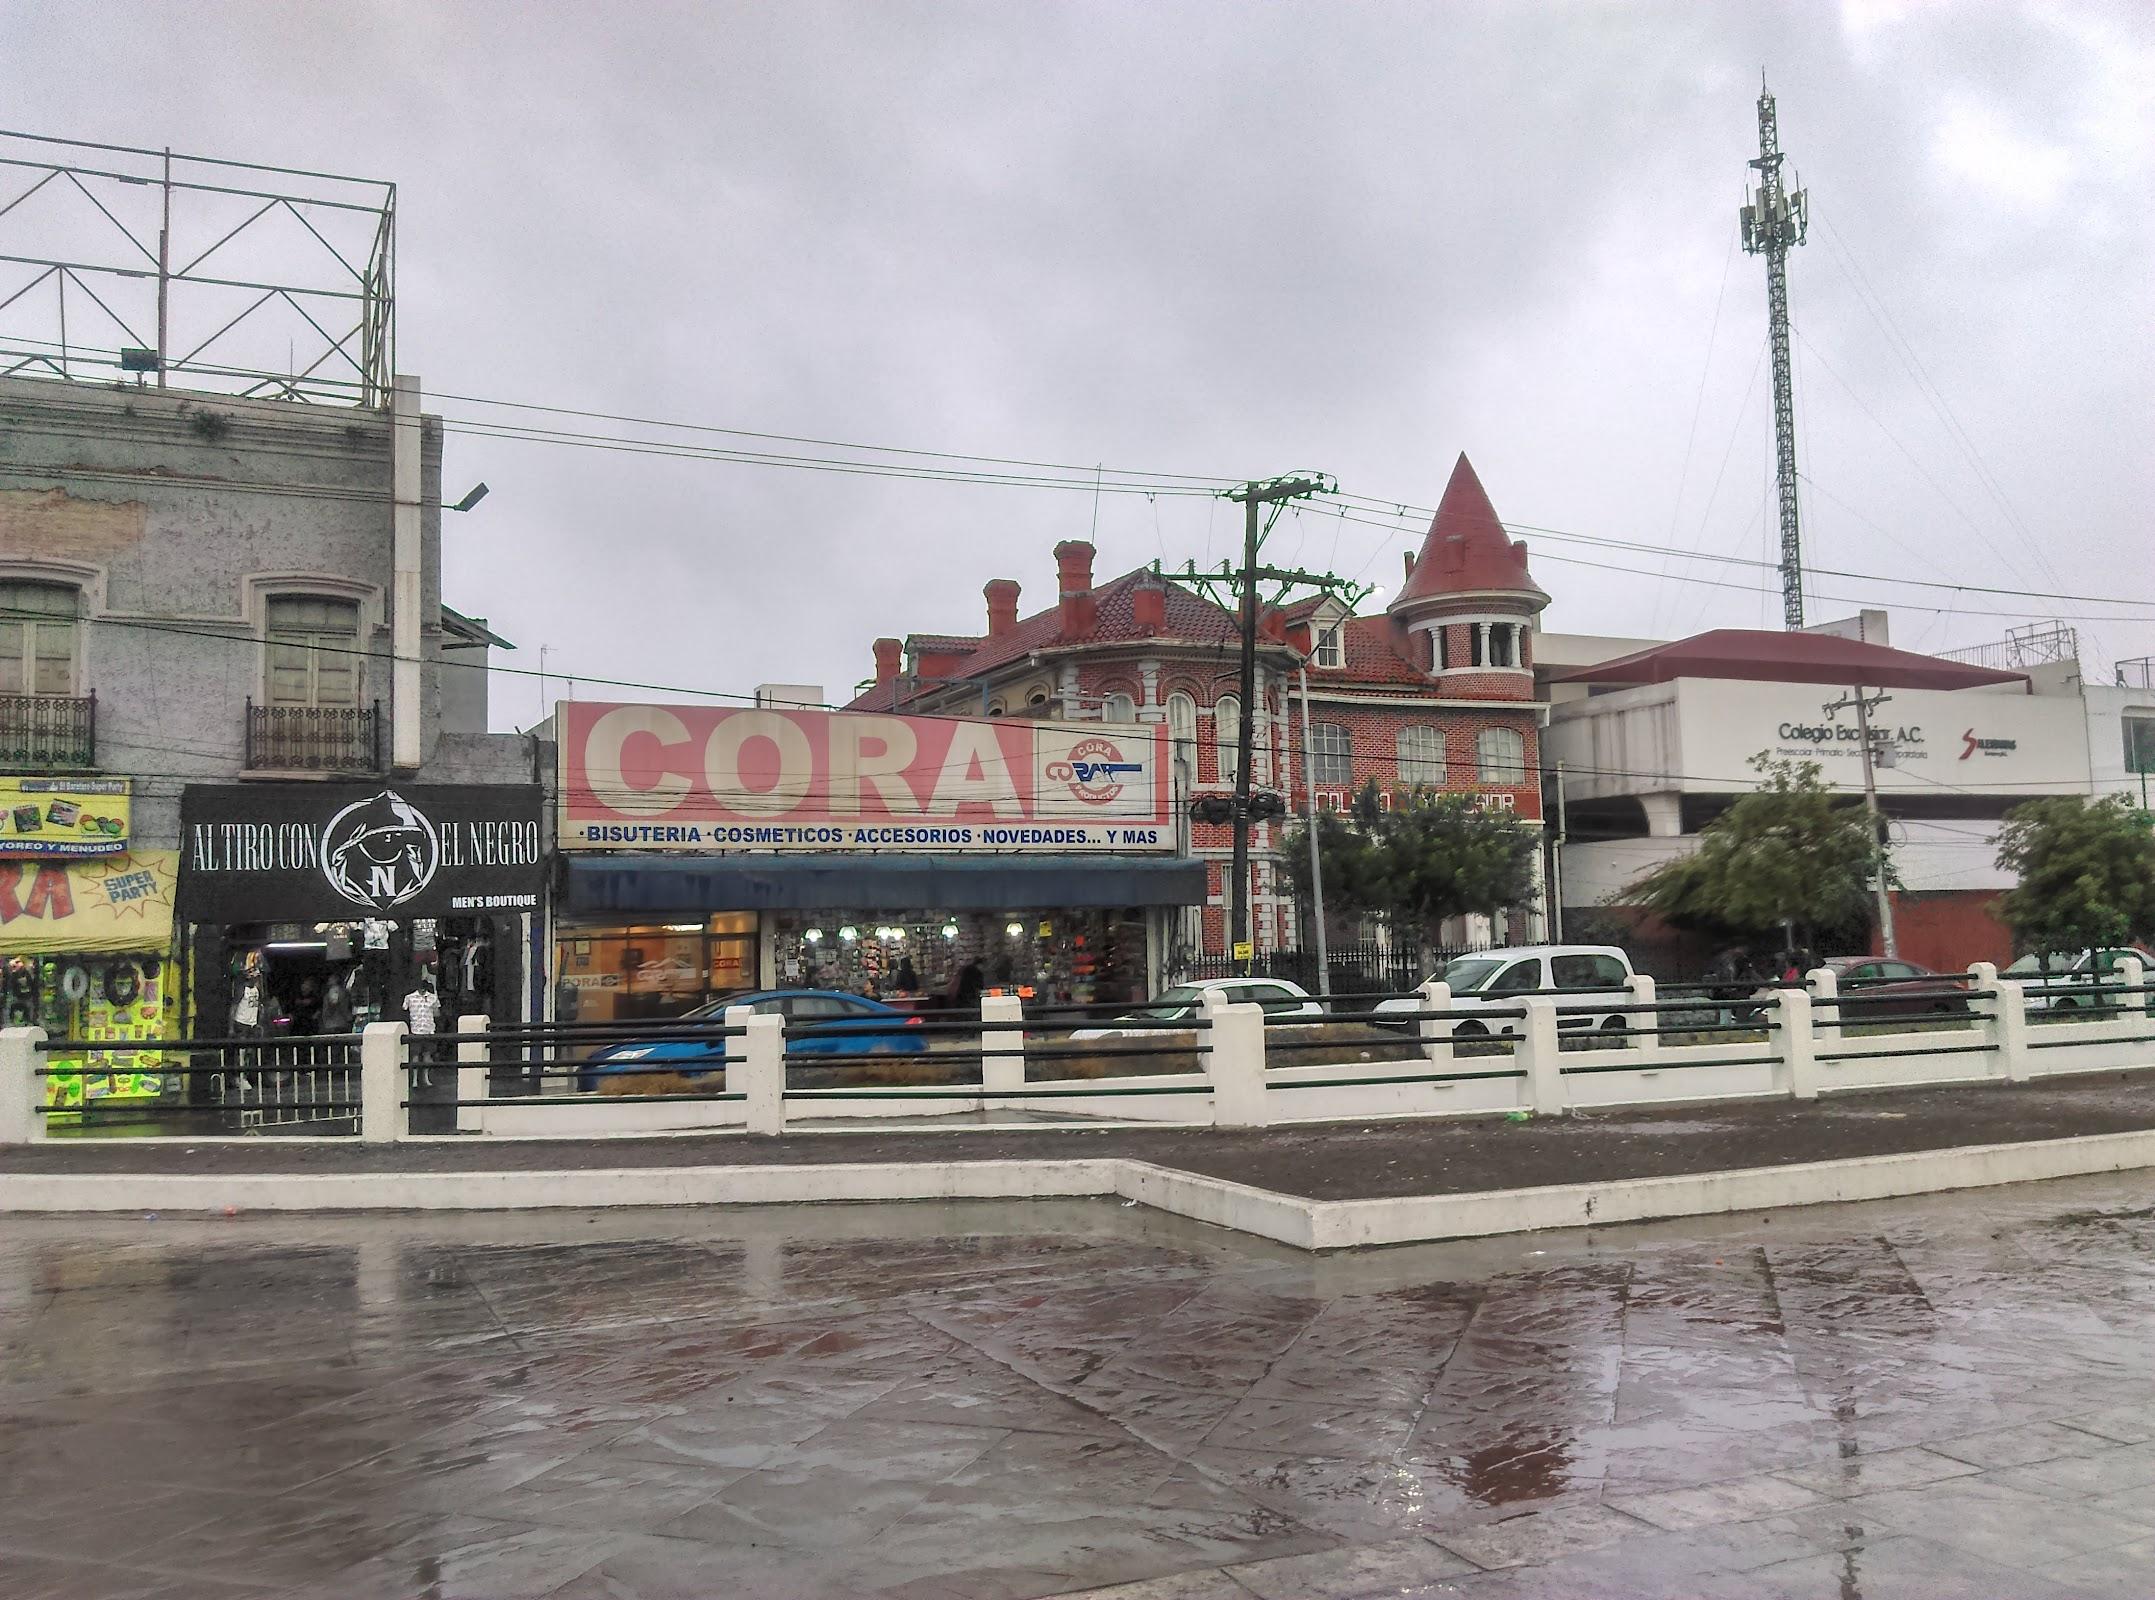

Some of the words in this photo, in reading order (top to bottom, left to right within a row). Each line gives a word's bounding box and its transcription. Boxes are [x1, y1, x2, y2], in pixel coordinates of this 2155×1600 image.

[1778, 723, 1833, 743] Colegio
[1897, 726, 1925, 743] A.C.
[1077, 742, 1112, 757] CORA
[585, 706, 1025, 819] CORA
[440, 822, 464, 867] EL
[470, 820, 538, 867] NEGRO
[587, 825, 701, 842] BISUTERIA
[714, 827, 843, 843] COSMETICOS
[854, 828, 972, 843] ACCESORIOS
[983, 829, 1101, 844] NOVEDADES...
[1106, 830, 1117, 844] Y
[1123, 830, 1158, 844] MAS
[47, 843, 56, 851] Y
[60, 843, 123, 852] MENUDEO
[192, 823, 219, 871] AL
[221, 823, 274, 871] TIRO
[278, 823, 317, 870] CON
[104, 869, 154, 892] SUPER
[109, 881, 158, 904] PARTY
[452, 896, 484, 909] MEN'S
[486, 894, 537, 908] BOUTIQUE
